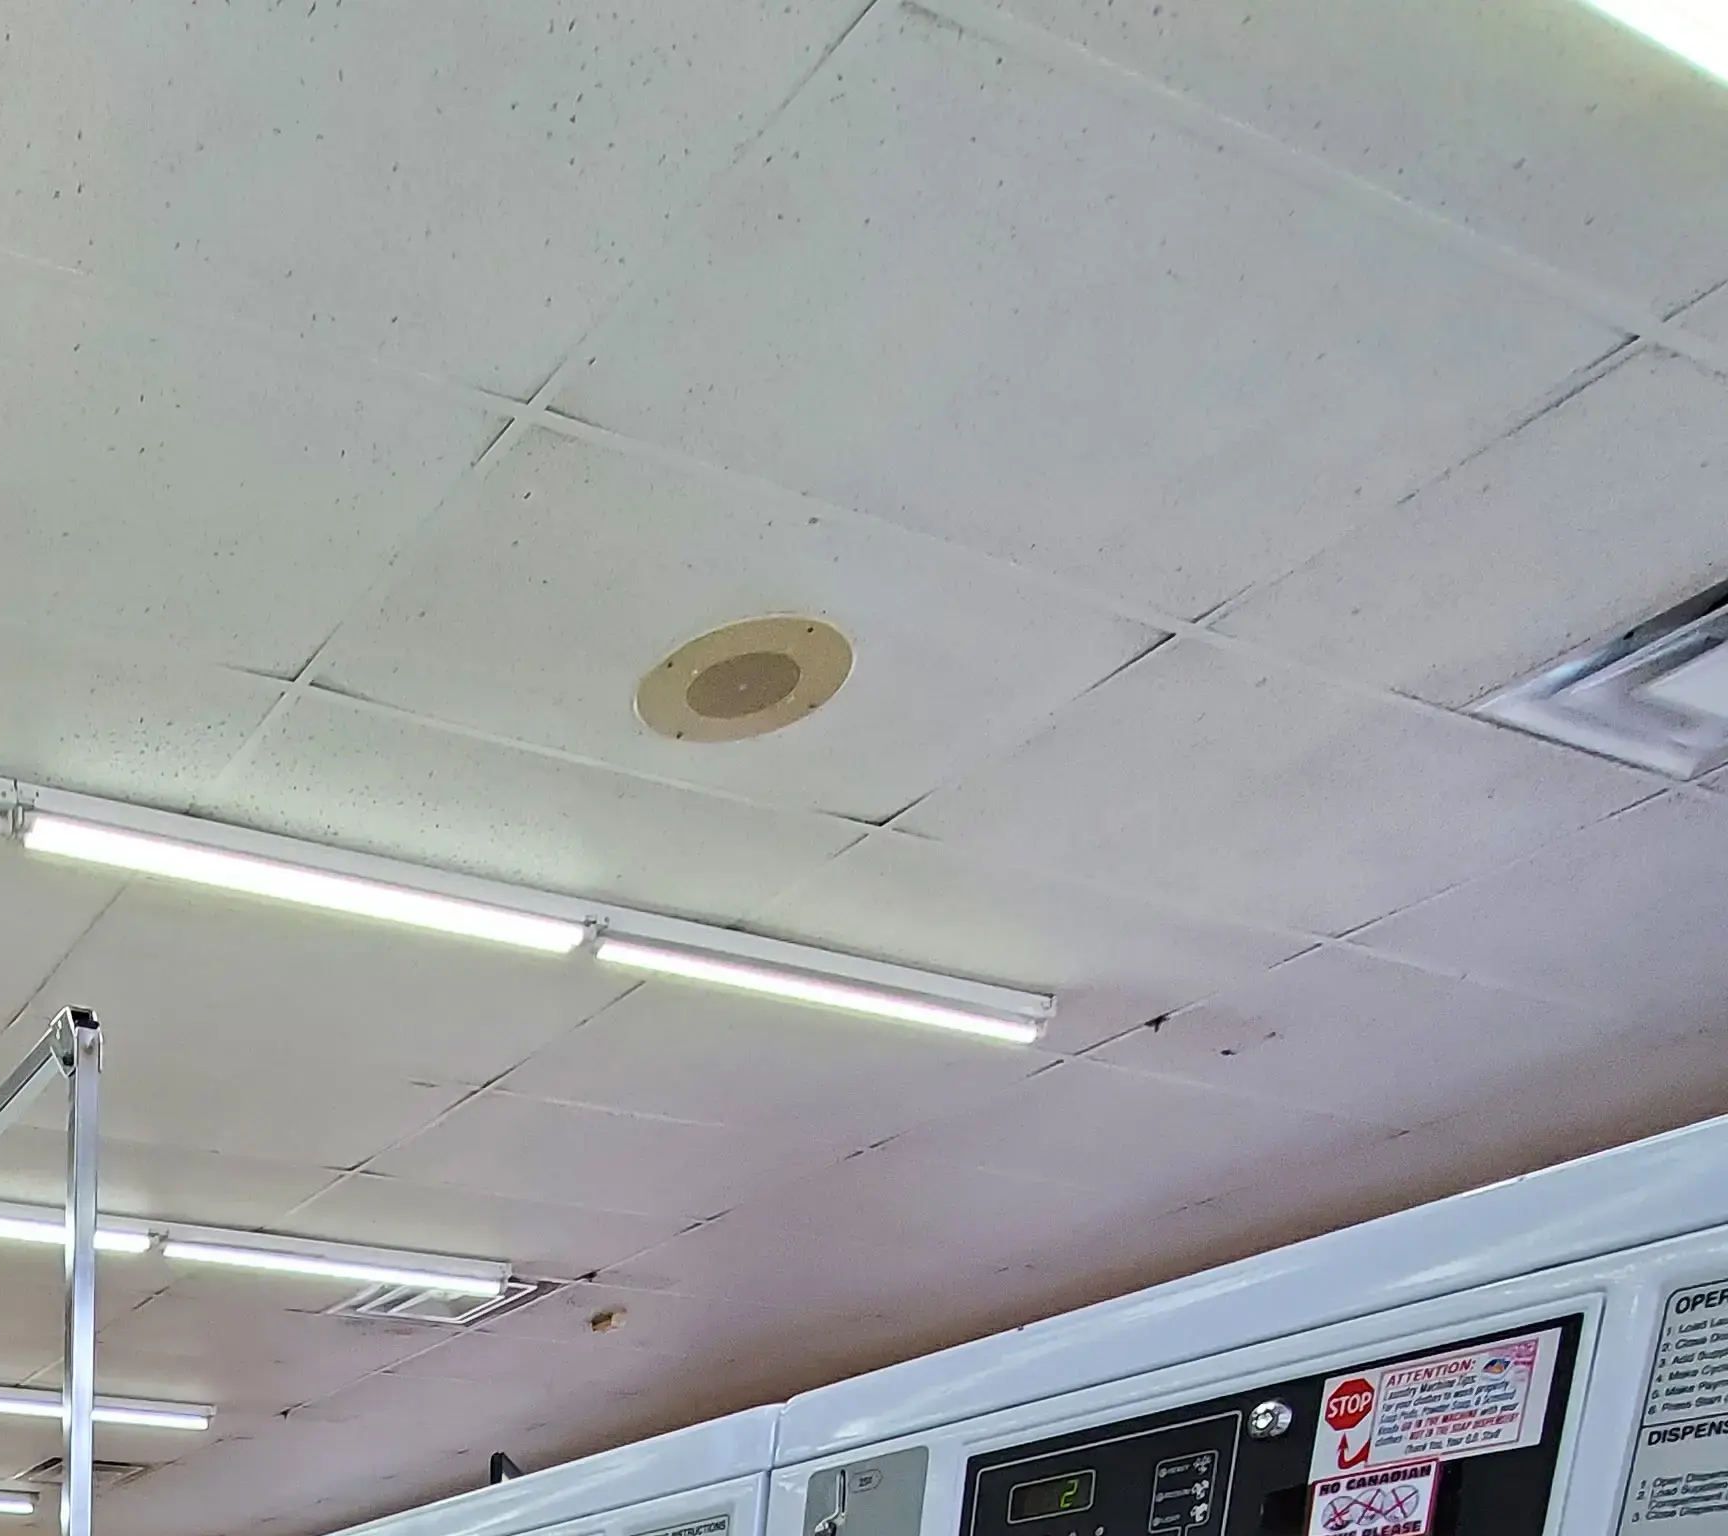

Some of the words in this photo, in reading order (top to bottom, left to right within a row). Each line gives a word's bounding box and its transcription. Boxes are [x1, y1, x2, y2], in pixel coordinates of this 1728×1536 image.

[1387, 1359, 1476, 1388] ATTENTION:
[1327, 1391, 1373, 1419] STOP
[1060, 1479, 1079, 1509] 2
[1319, 1481, 1341, 1497] NO
[1346, 1464, 1433, 1491] CANADIAN
